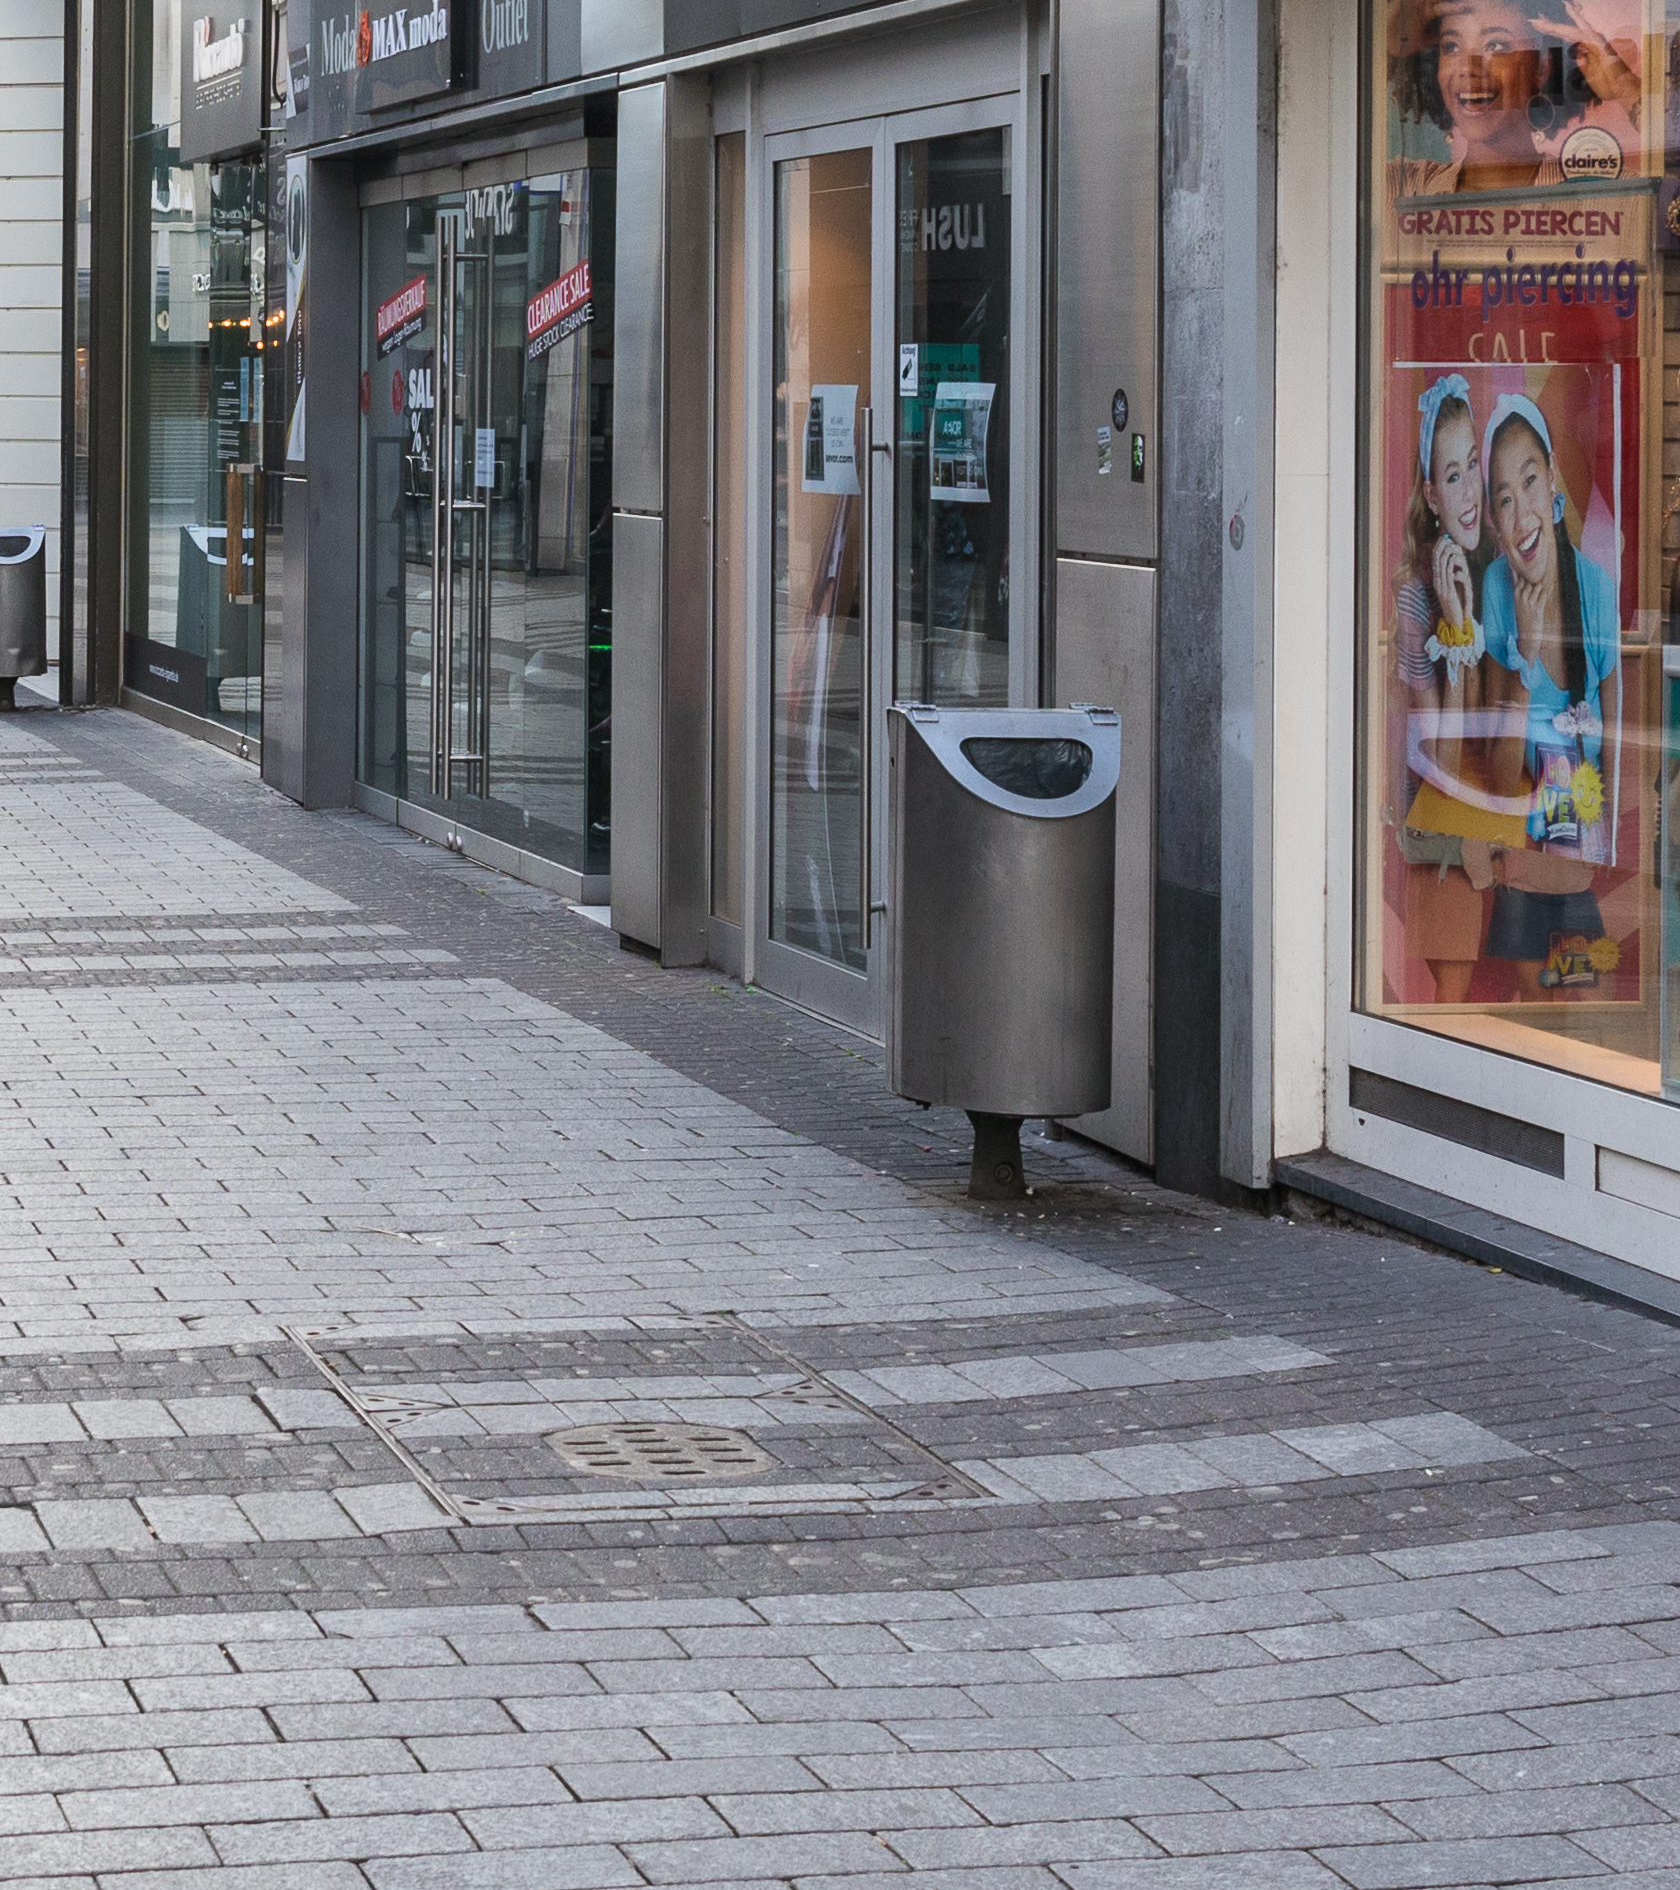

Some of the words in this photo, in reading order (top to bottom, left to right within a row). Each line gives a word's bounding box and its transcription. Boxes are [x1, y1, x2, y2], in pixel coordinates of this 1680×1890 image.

[371, 8, 409, 62] MAX
[1563, 152, 1618, 170] claire's
[1398, 209, 1495, 236] GRATIS
[1503, 210, 1622, 237] PIERCEN
[527, 278, 570, 334] CLEARANCE
[570, 263, 590, 305] SALE
[1411, 248, 1471, 310] ohr
[1481, 242, 1637, 324] piercing
[407, 367, 435, 410] SAL
